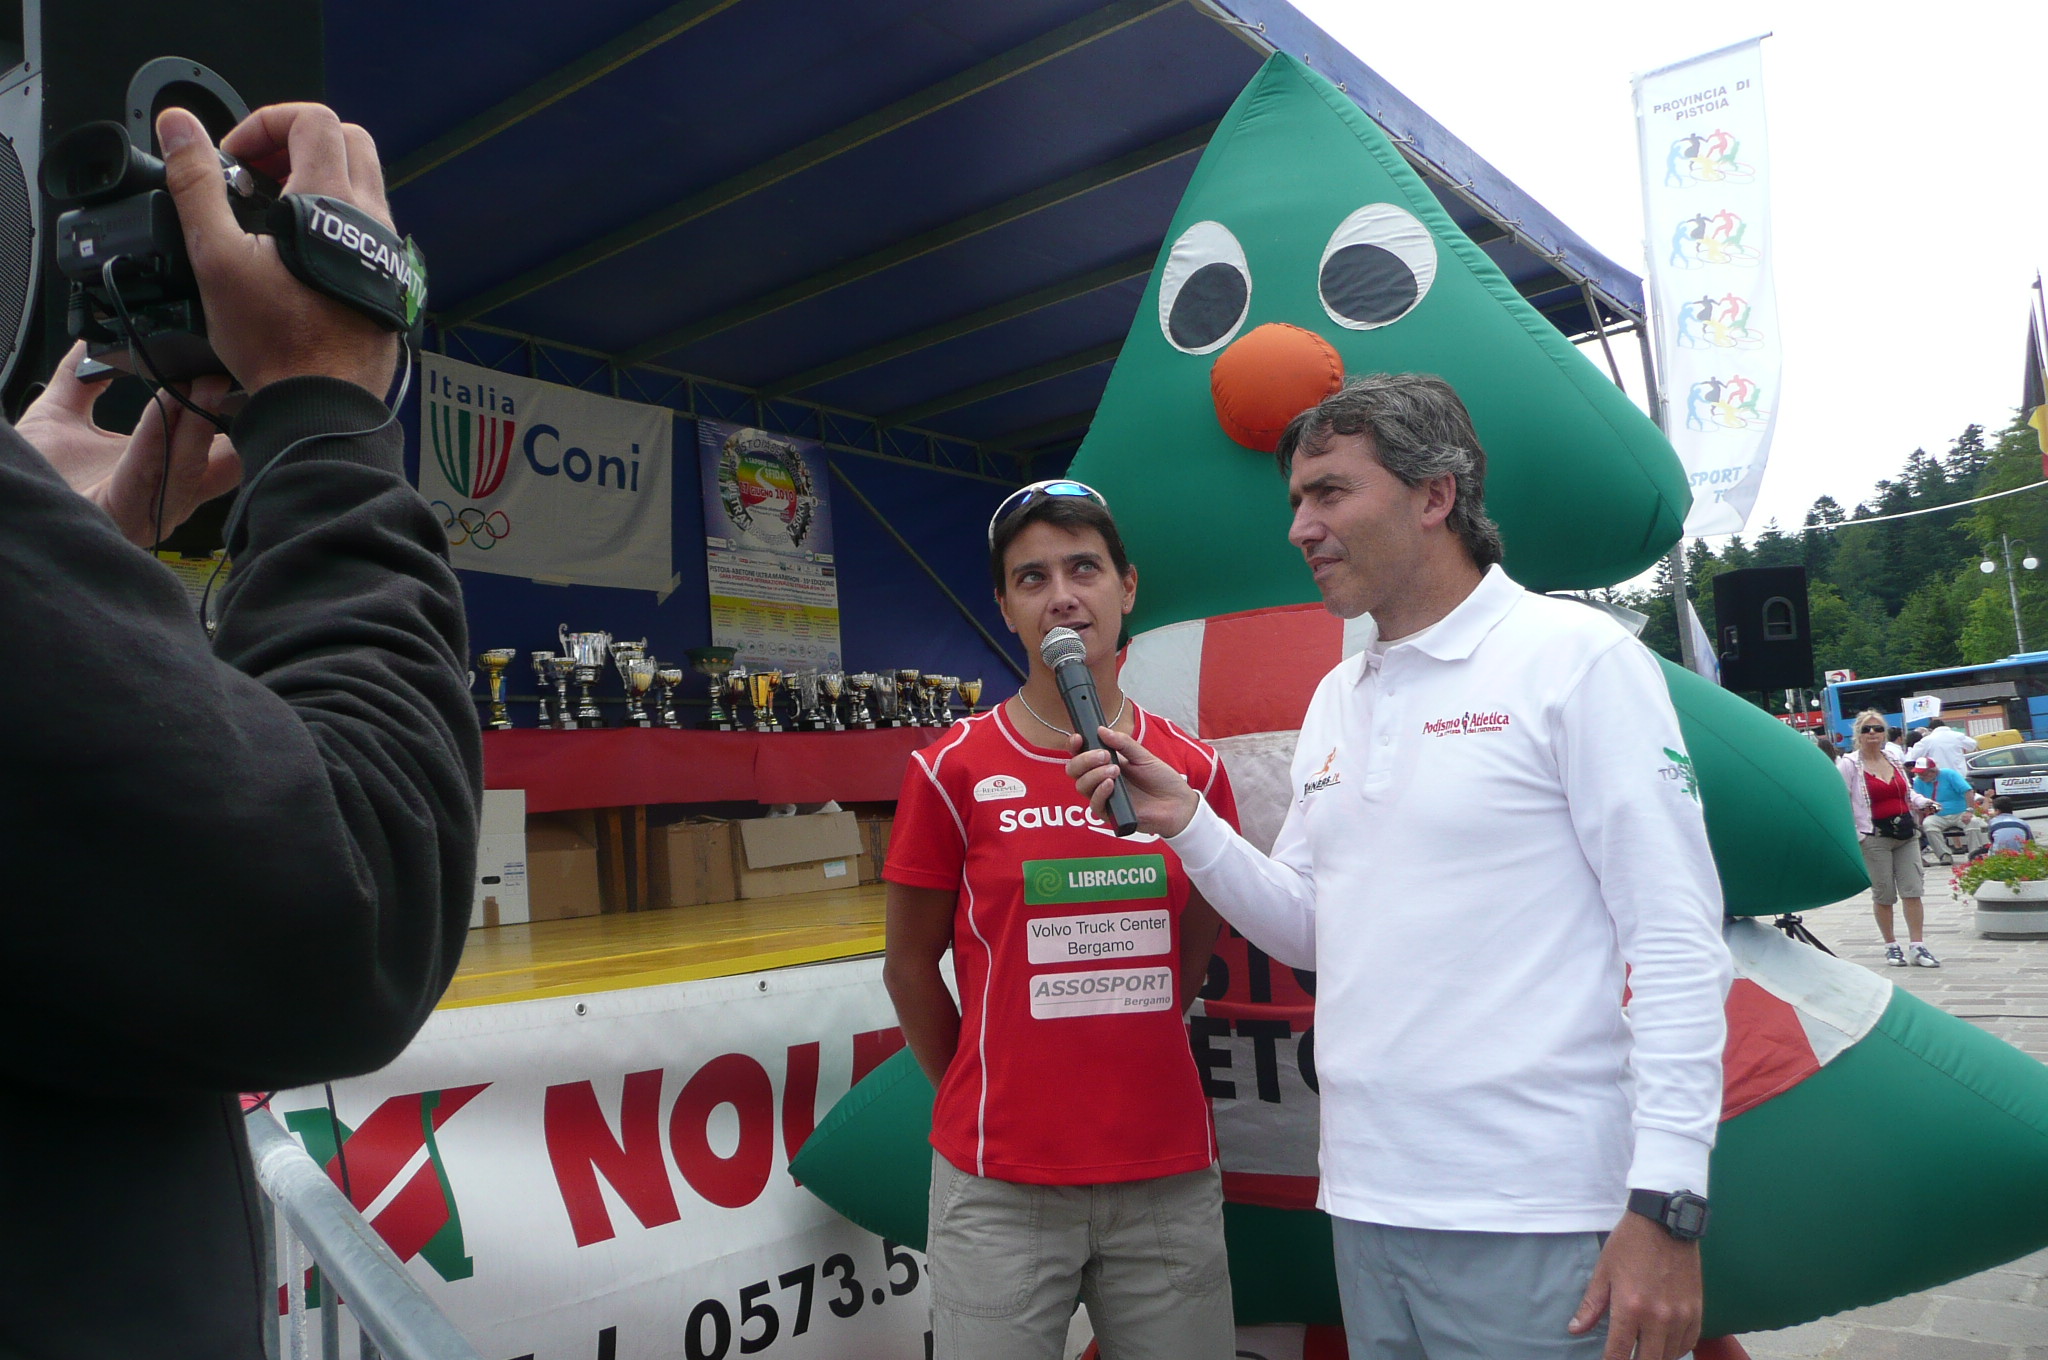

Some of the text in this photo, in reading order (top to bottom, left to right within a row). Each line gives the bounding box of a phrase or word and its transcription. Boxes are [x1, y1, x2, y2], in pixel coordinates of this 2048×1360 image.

[1653, 79, 1750, 114] PROVINCIA DI
[1676, 97, 1729, 120] PISTOIA
[430, 370, 515, 415] Italia
[523, 424, 640, 492] Coni
[765, 468, 787, 480] SFIDA
[1689, 466, 1743, 488] SPORT
[751, 487, 774, 498] GIUGNO
[1422, 711, 1510, 735] Podismo Atletica
[1068, 867, 1157, 888] LIBRACCIO
[1031, 917, 1167, 938] Volvo Truck Center
[1068, 940, 1135, 956] Bergamo
[1034, 973, 1169, 998] ASSOSPORT
[1124, 996, 1171, 1007] Bergamo
[684, 1238, 929, 1360] 0573.5
